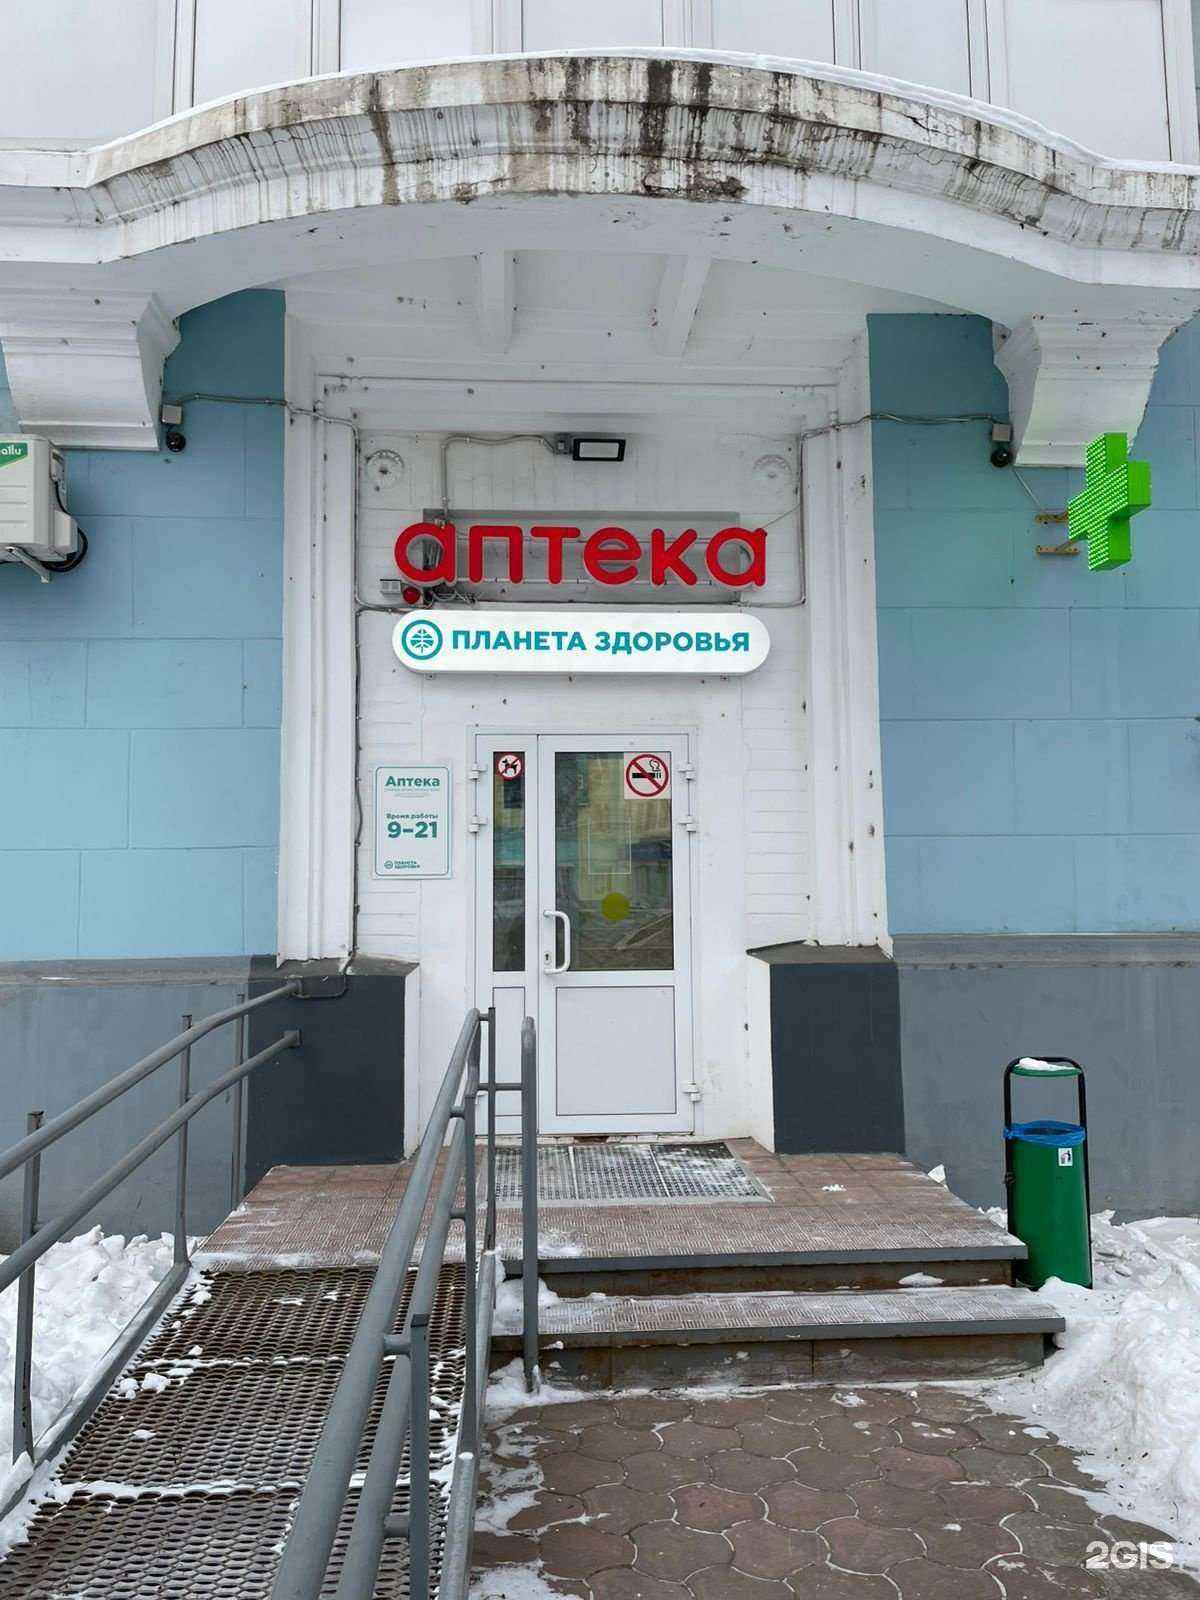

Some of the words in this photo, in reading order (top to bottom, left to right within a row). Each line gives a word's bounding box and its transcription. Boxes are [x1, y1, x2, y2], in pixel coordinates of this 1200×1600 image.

[394, 522, 768, 587] аптека
[452, 630, 587, 652] ПЛАНЕТА
[595, 631, 750, 656] ЗДОРОВЬЯ
[385, 775, 441, 787] Аптека
